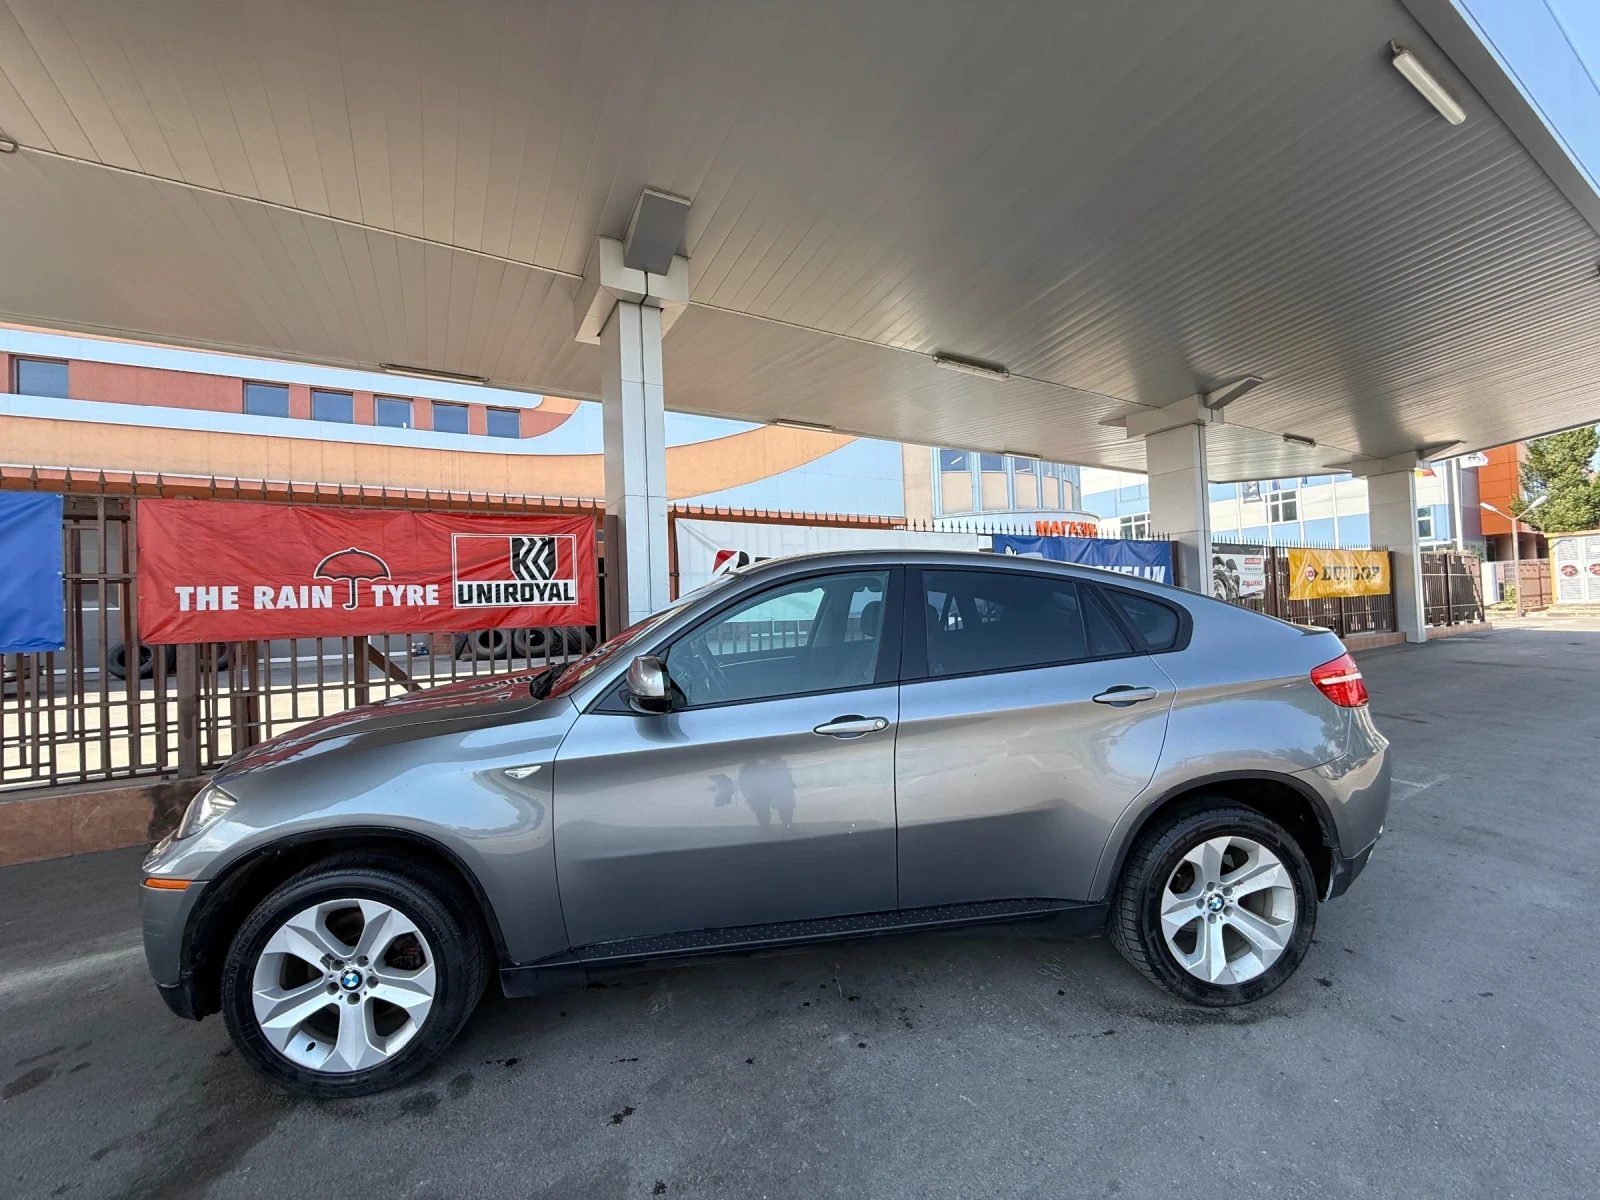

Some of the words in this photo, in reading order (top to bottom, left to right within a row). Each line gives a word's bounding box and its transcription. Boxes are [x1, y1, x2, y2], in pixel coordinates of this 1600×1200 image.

[1035, 520, 1098, 538] МАГАЗИН
[175, 585, 239, 612] THE
[253, 585, 333, 611] RAIN
[370, 584, 439, 608] TYRE
[457, 582, 575, 605] UNIROYAL
